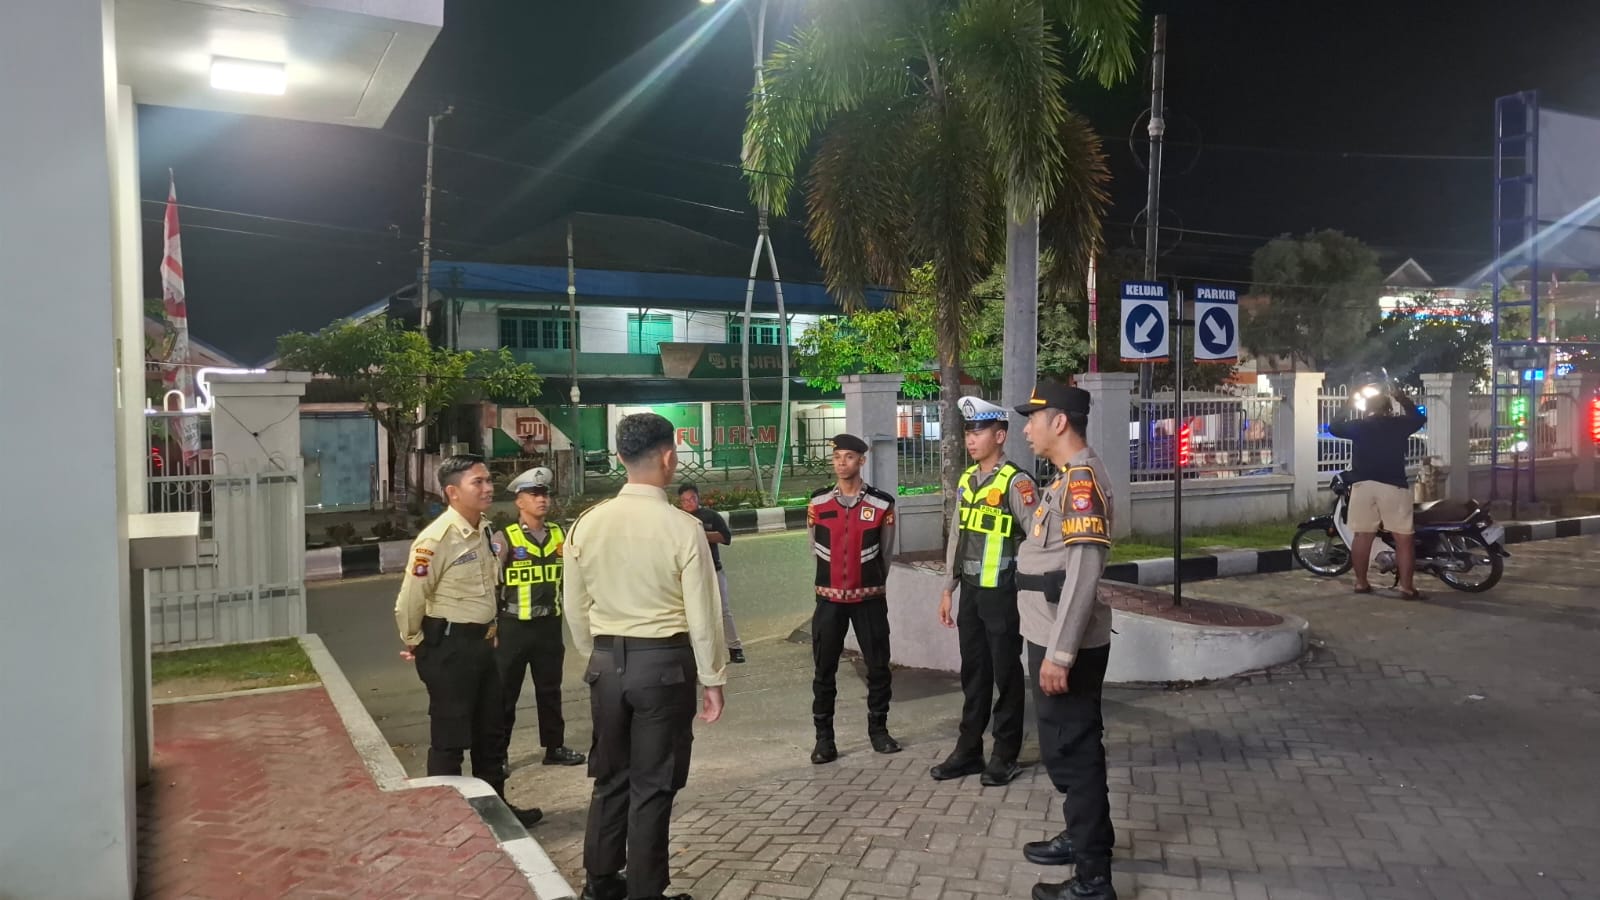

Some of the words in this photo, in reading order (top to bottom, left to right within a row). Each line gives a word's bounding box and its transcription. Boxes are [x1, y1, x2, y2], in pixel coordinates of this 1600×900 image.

[1125, 284, 1164, 297] KELUAR
[1197, 287, 1236, 301] PARKIR
[730, 354, 798, 369] FJIFILM
[675, 427, 725, 446] FUI
[728, 425, 777, 445] FIM
